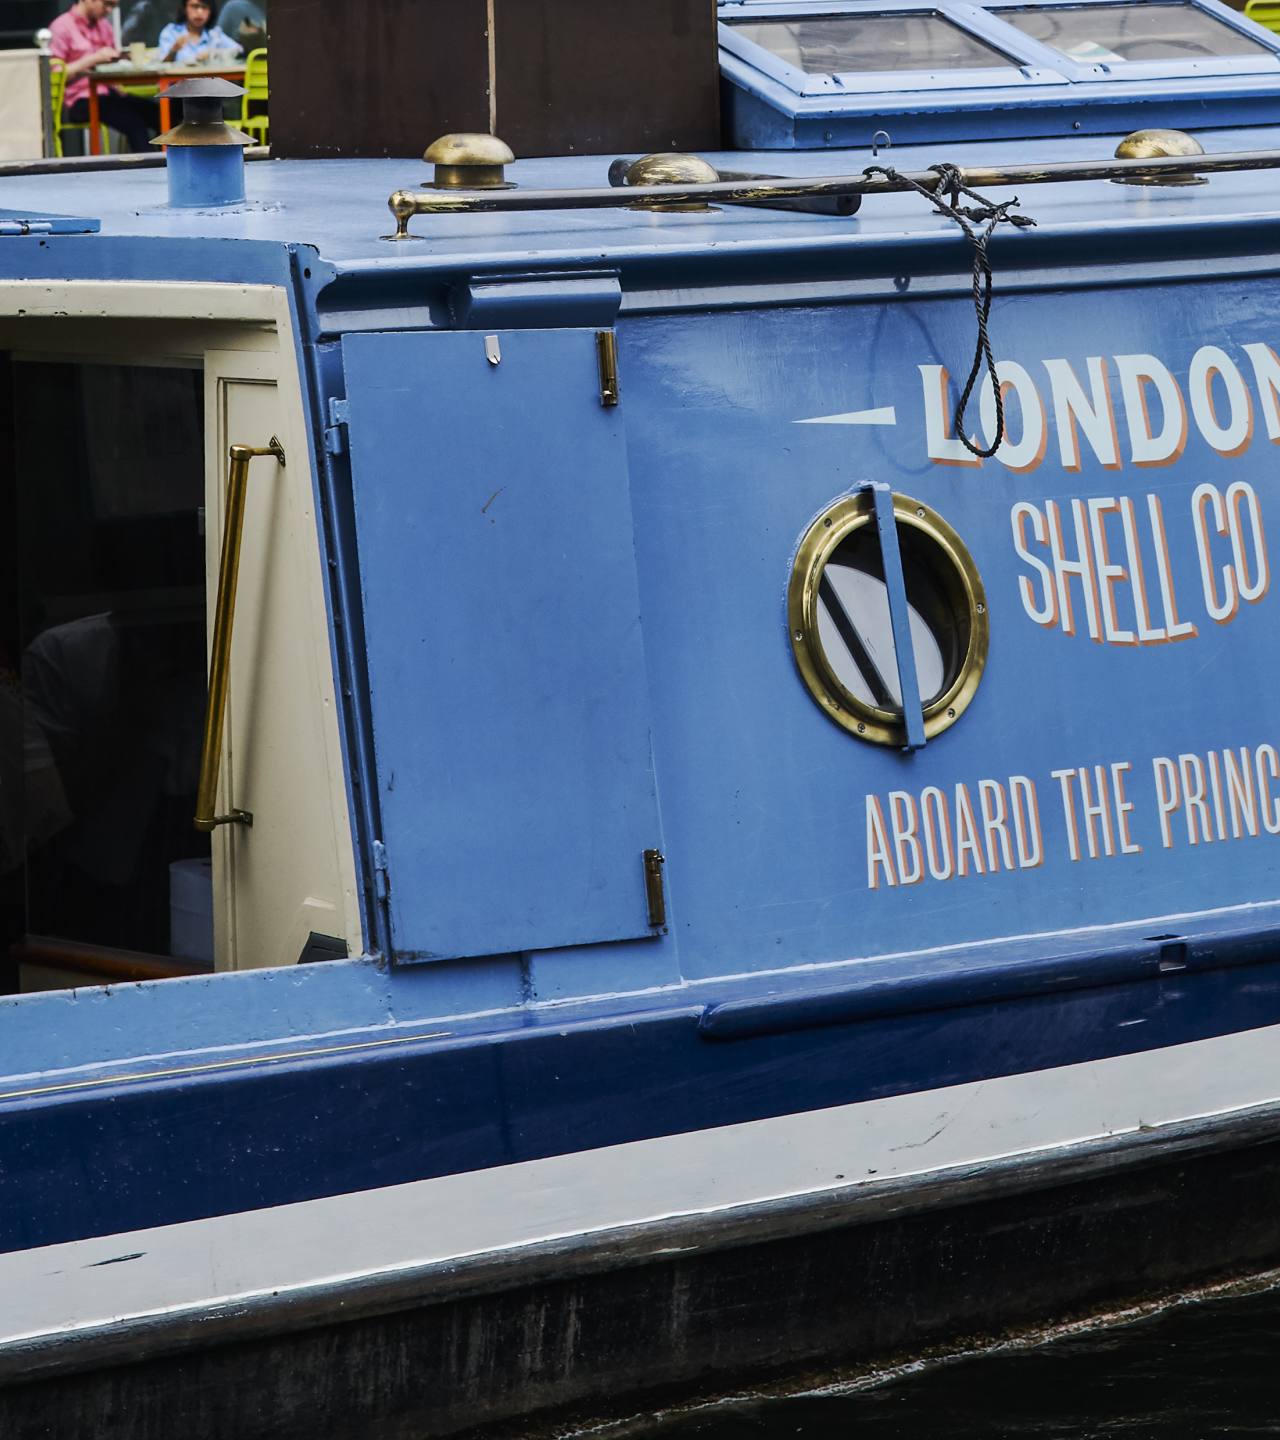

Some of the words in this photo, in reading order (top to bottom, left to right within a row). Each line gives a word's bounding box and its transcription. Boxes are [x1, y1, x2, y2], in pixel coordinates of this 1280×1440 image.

[1010, 493, 1199, 648] SHELL
[1191, 480, 1271, 625] CO
[864, 774, 1045, 890] ABOARD
[1051, 761, 1141, 862] THE
